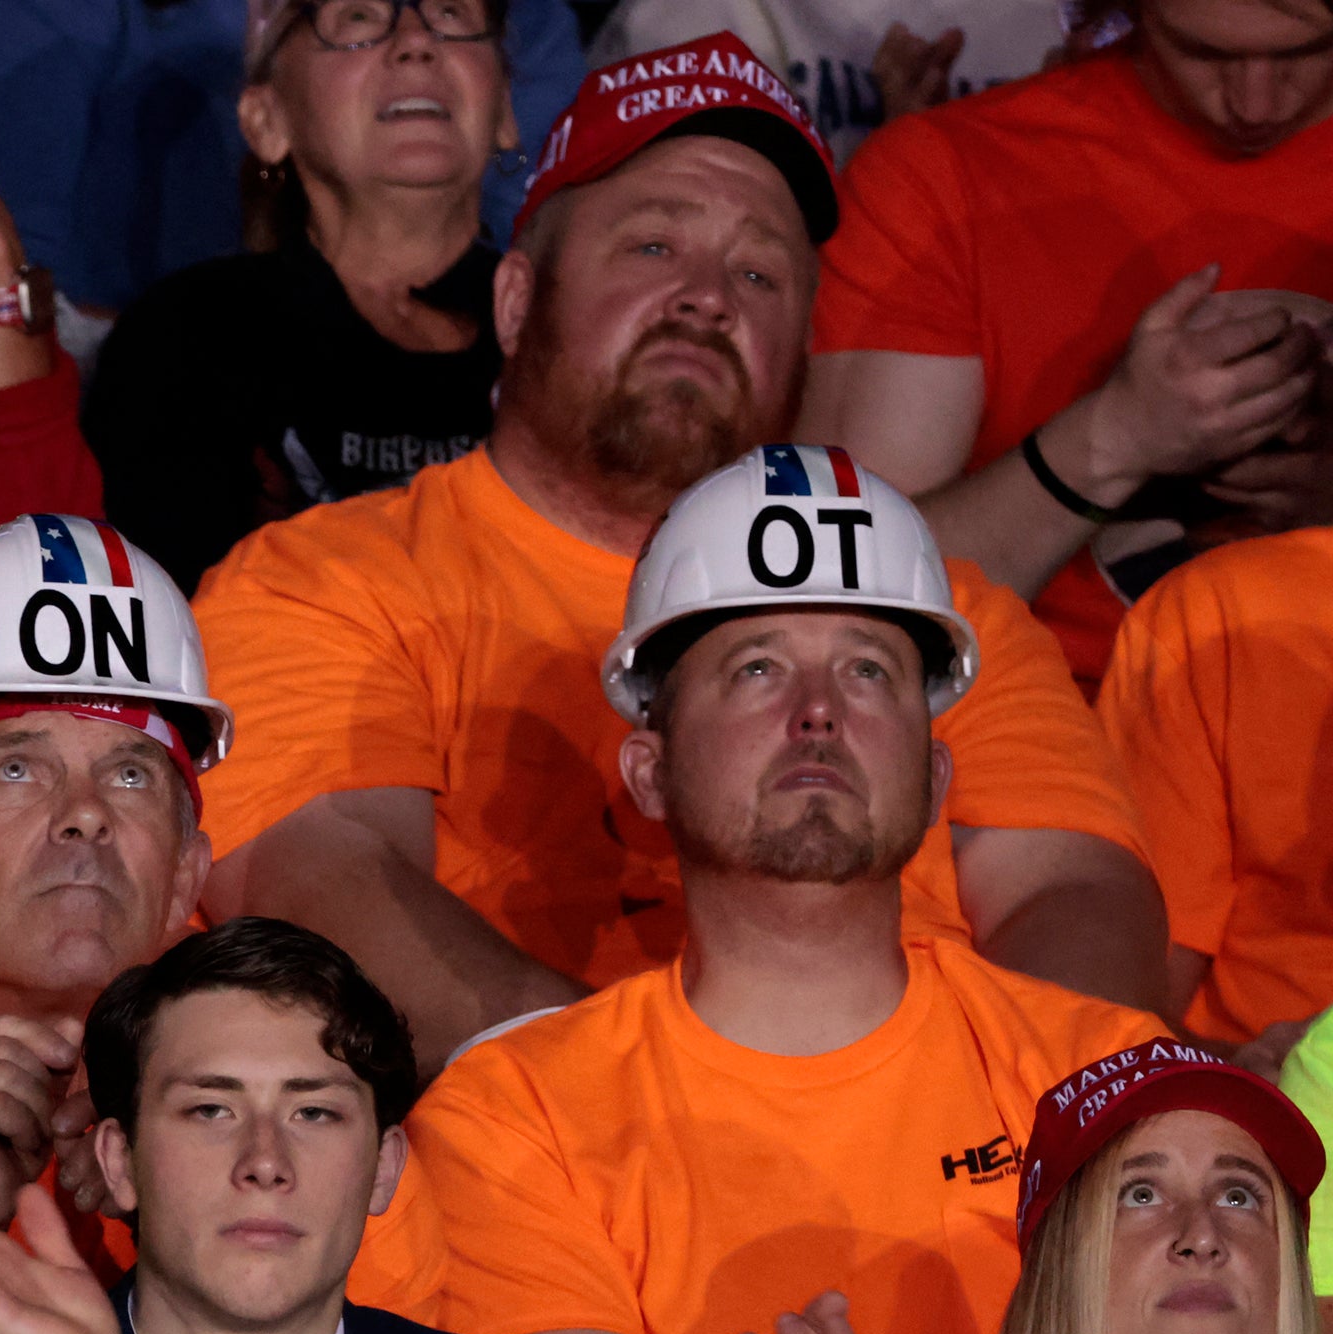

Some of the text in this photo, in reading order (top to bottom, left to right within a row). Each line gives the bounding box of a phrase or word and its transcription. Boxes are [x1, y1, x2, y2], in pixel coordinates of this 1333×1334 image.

[597, 51, 699, 95] MAKE
[616, 83, 729, 124] GREAT
[747, 504, 872, 589] OT
[20, 589, 151, 683] ON
[1051, 1049, 1140, 1115] MAKE
